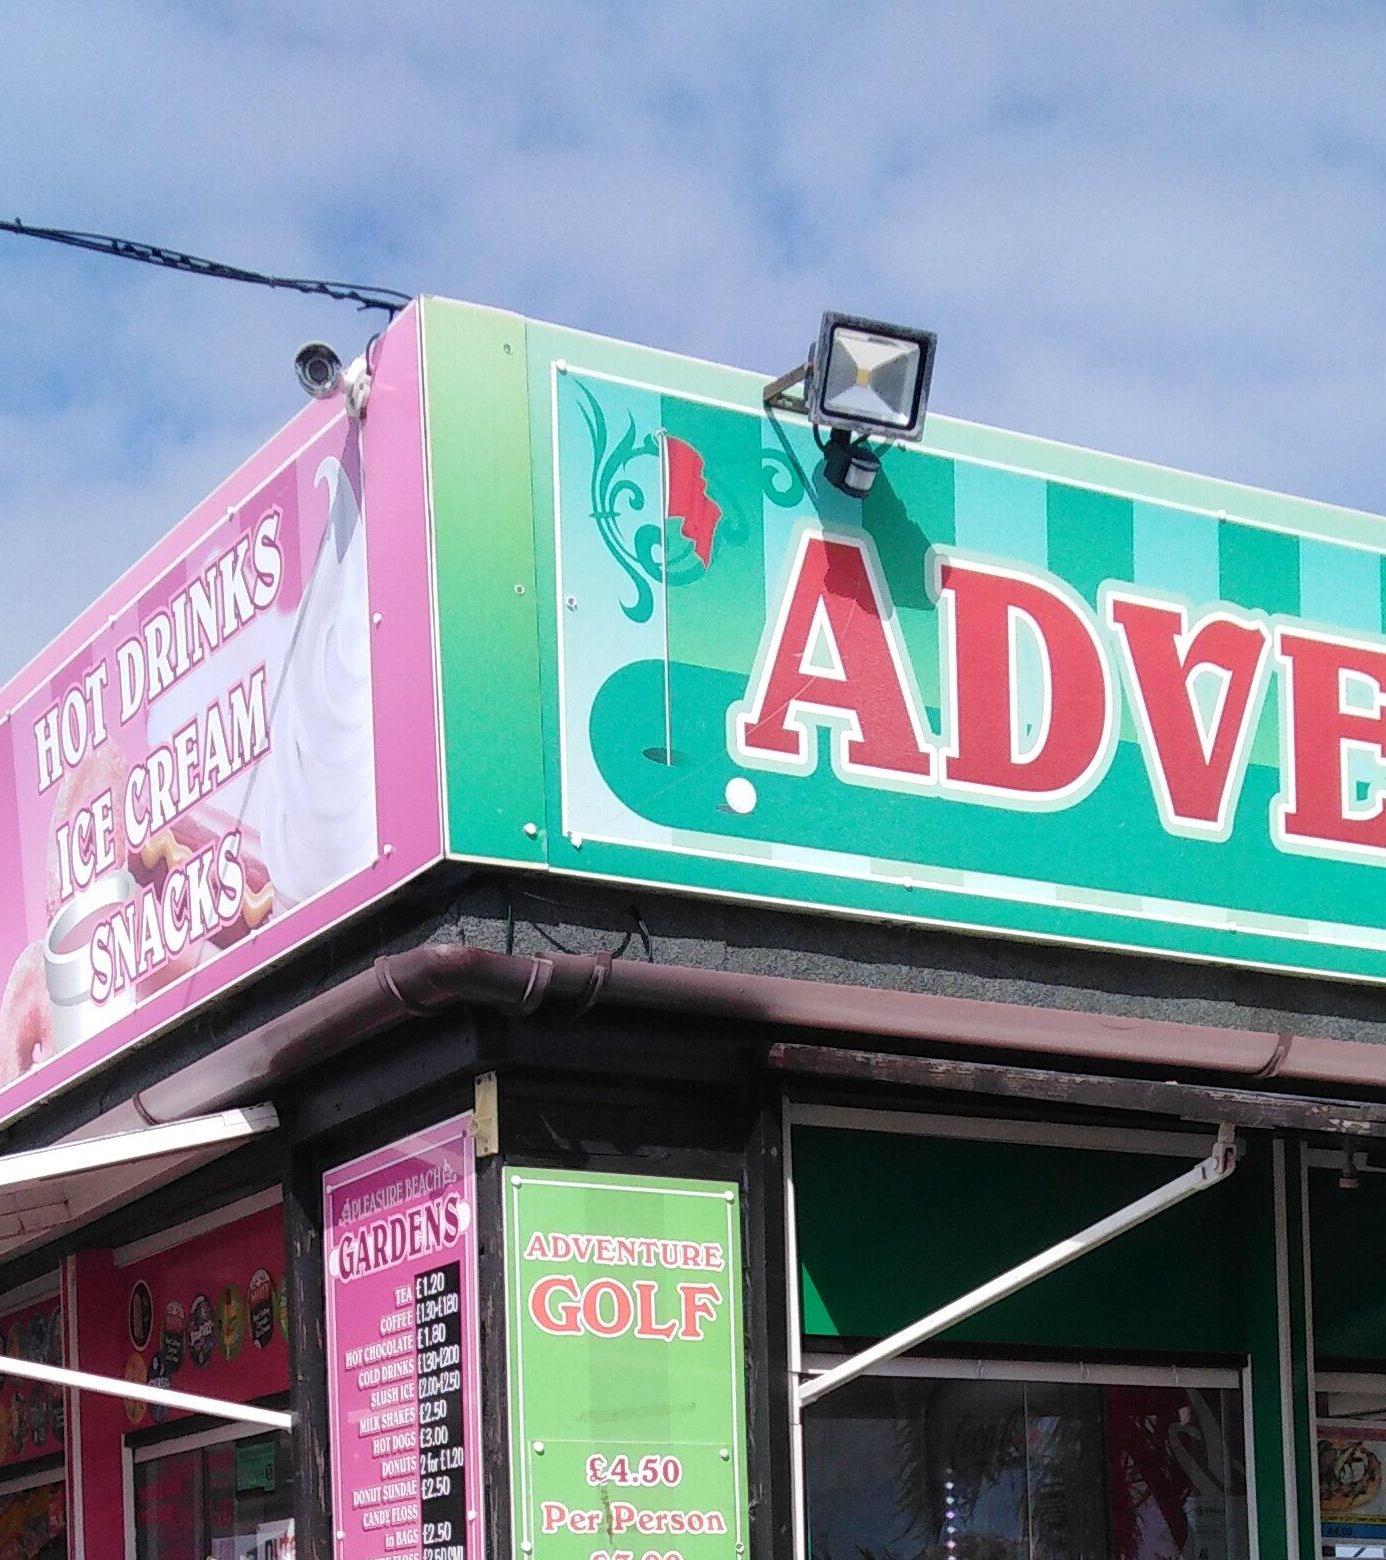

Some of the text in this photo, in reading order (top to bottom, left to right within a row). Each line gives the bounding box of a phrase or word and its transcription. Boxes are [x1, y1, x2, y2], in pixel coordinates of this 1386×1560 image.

[34, 506, 282, 795] HOT DRINKS
[57, 666, 269, 900] ICE CREAM
[90, 828, 244, 1002] SNACKS
[352, 1167, 443, 1219] PLEASURE BEACH
[339, 1194, 460, 1282] GARDENS
[526, 1232, 723, 1270] ADVENTURE
[395, 1272, 445, 1304] TEA £1.20
[380, 1310, 412, 1335] COFFEE
[531, 1277, 721, 1339] GOLF
[346, 1323, 447, 1368] HOT CHOCOLATE £1.80
[358, 1368, 381, 1386] COLD
[382, 1359, 413, 1383] DRINKS
[371, 1387, 399, 1408] SLUSH
[400, 1383, 414, 1400] ICE
[359, 1399, 447, 1435] MILK SHAKES £2.50
[373, 1425, 449, 1454] HOT DOGS £3.00
[381, 1447, 464, 1477] DONUTS 2 for £1.20
[588, 1456, 681, 1485] £4.50
[353, 1476, 451, 1507] DONUT SUNDAE £2.50
[363, 1504, 417, 1528] CANDY FLOSS
[543, 1503, 725, 1532] Per Person
[386, 1521, 451, 1548] in BAGS £2.50
